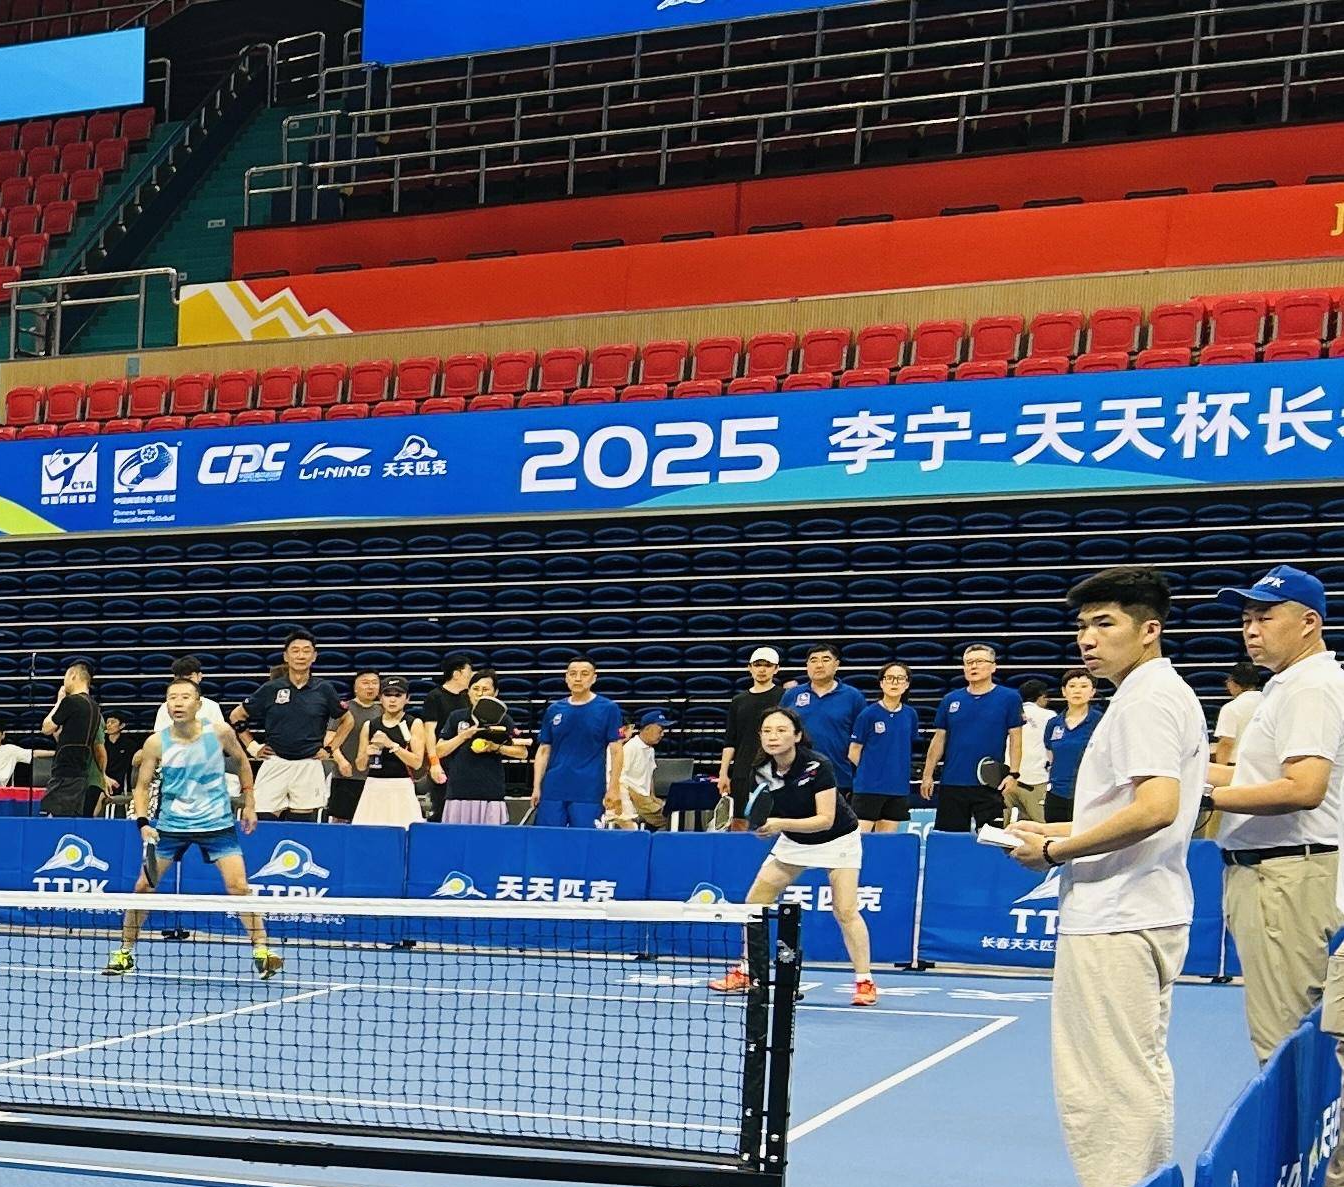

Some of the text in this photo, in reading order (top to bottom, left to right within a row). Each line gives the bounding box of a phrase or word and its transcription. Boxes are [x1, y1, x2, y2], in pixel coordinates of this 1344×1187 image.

[520, 386, 1344, 494] 2025 李宁-天天杯长
[197, 442, 290, 485] CPC
[298, 463, 372, 481] LI-NING
[382, 459, 447, 478] 天天匹克
[71, 480, 94, 490] CTA
[495, 875, 617, 901] 天天匹克
[1009, 908, 1060, 935] TT
[981, 936, 1057, 952] 长春天天匹
